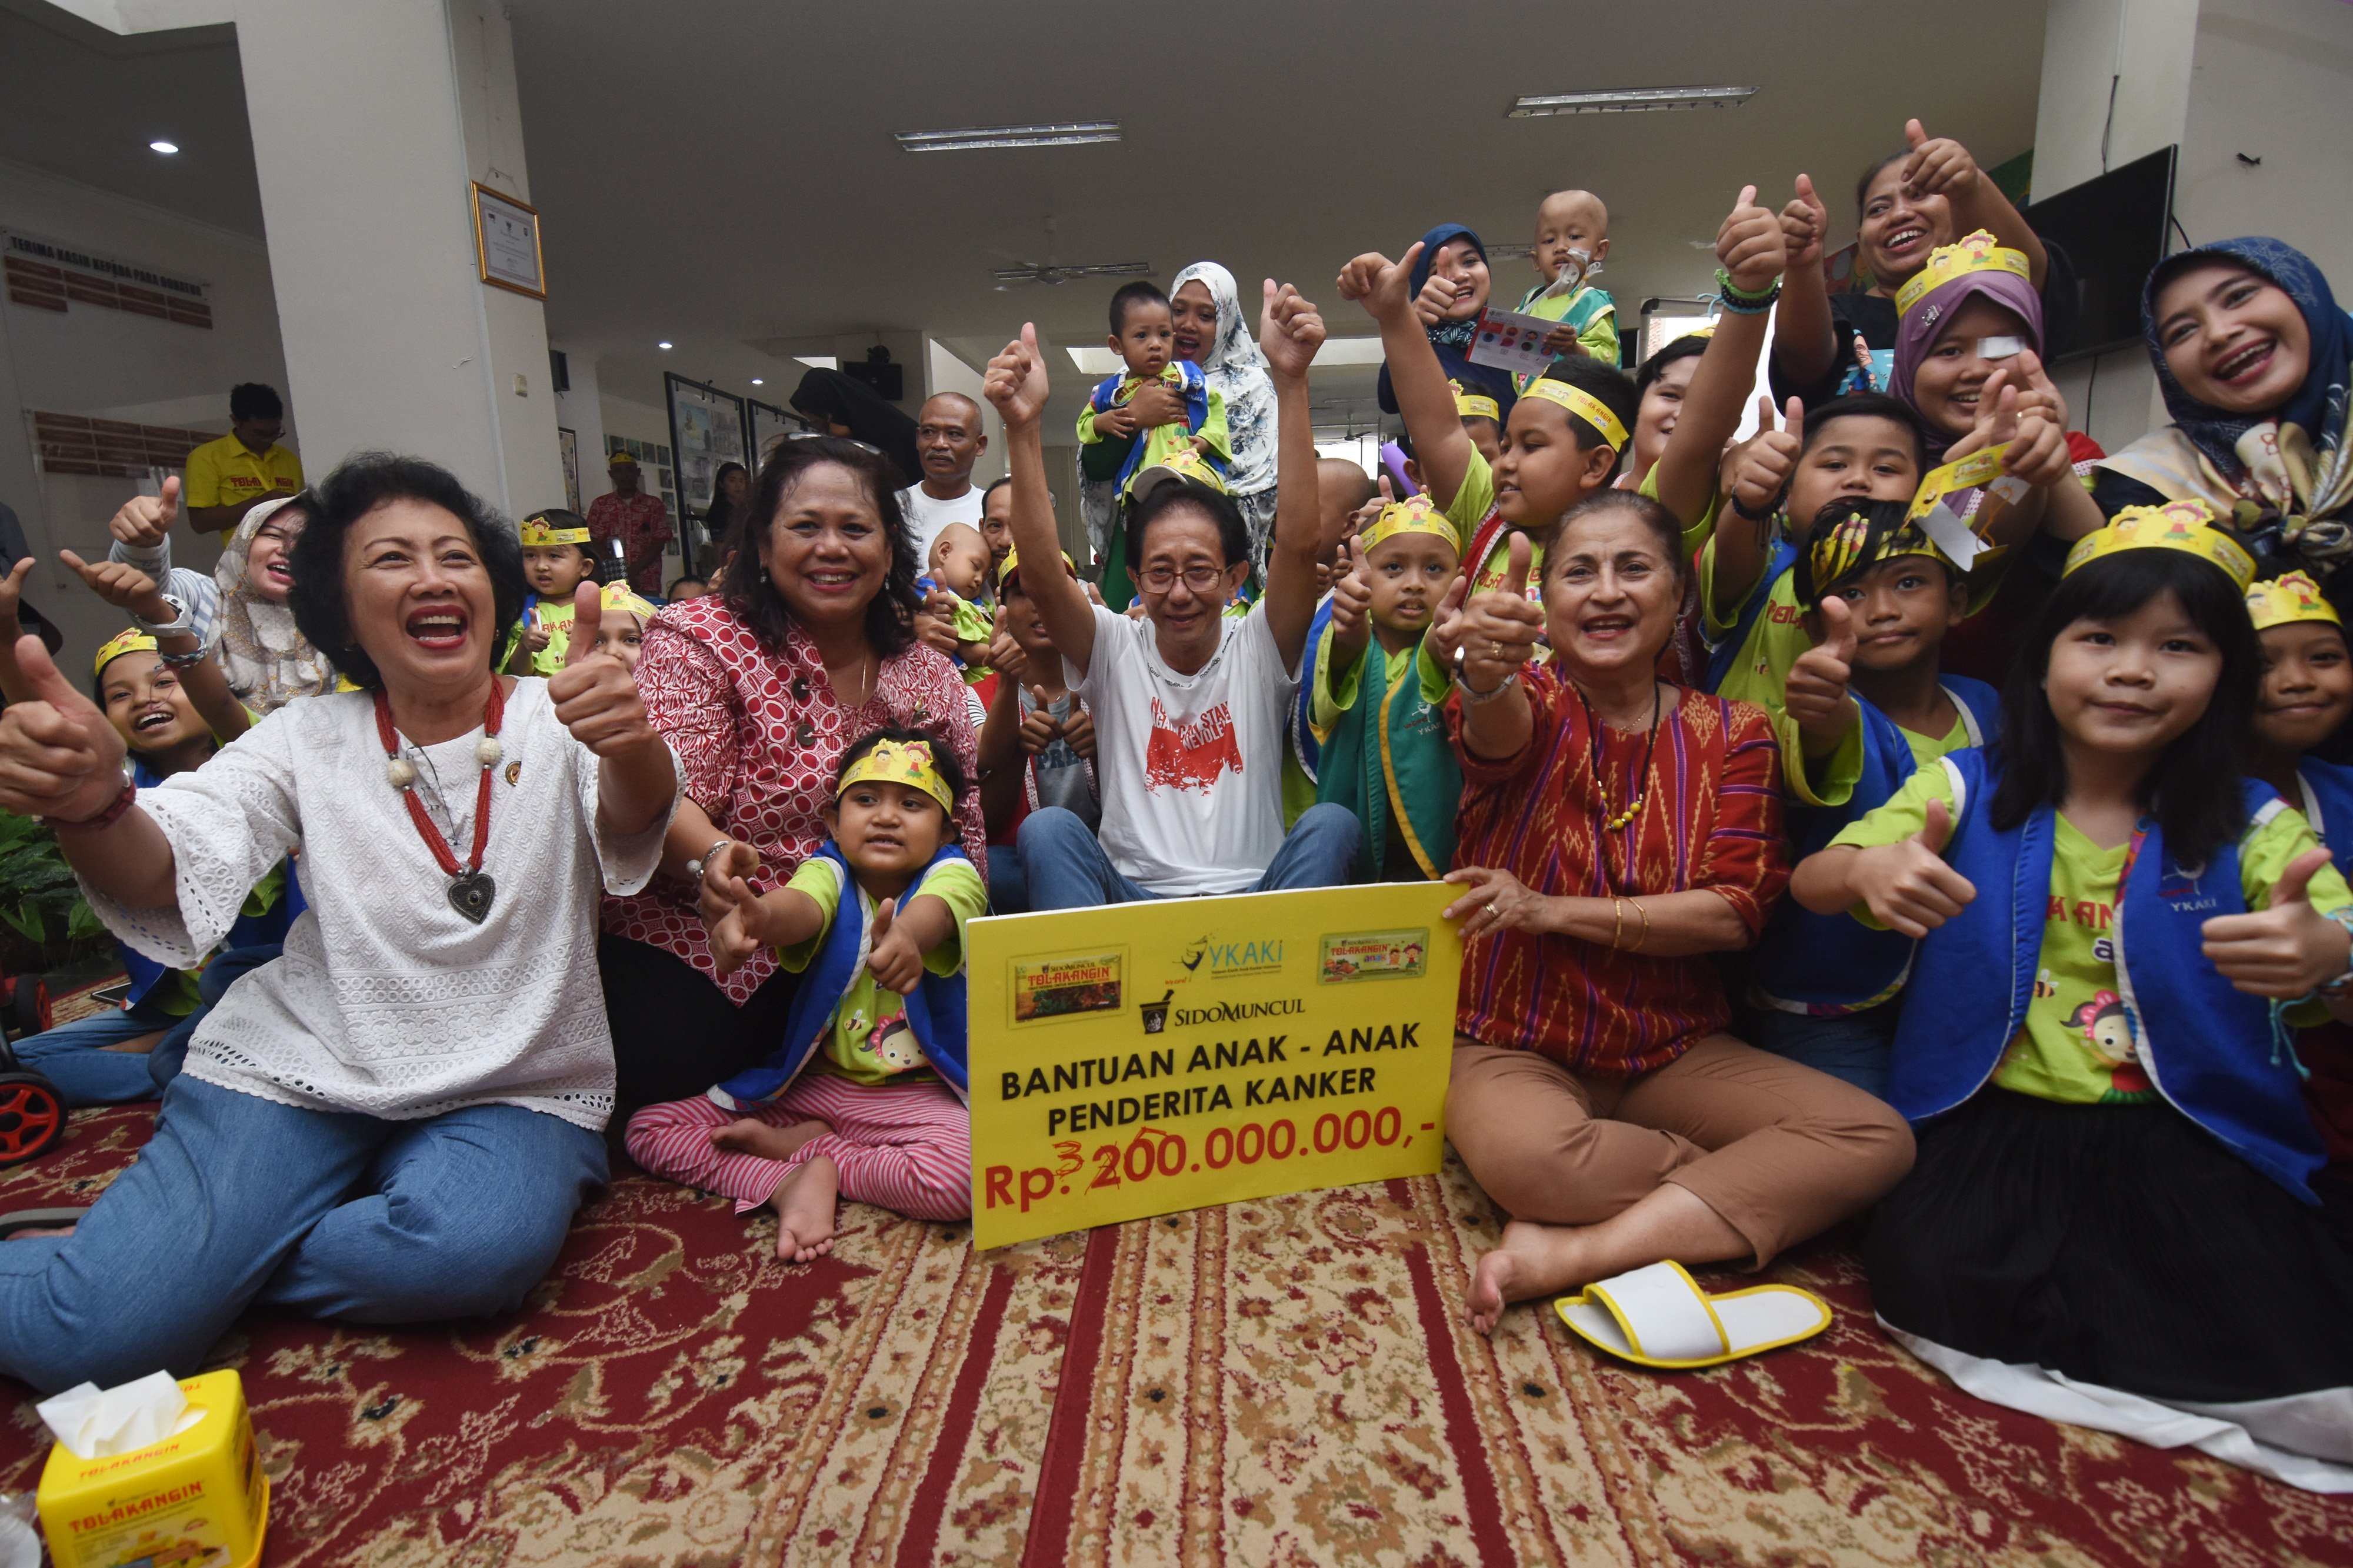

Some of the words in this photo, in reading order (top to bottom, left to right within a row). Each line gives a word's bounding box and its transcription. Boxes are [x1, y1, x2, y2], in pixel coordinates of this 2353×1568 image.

[11, 236, 55, 259] TERIMA
[56, 248, 91, 268] KASIH
[134, 269, 159, 286] PARA
[1577, 395, 1596, 411] TOLAK
[1595, 408, 1612, 423] ANGIN
[230, 476, 262, 487] TOLA
[2170, 898, 2217, 912] YKAKI
[1175, 998, 1305, 1027] SIDOMUNCUL
[1001, 1049, 1175, 1101] BANTUAN
[1187, 1036, 1288, 1074] ANAK
[1323, 1023, 1421, 1057] ANAK
[1048, 1086, 1233, 1136] PENDERITA
[1245, 1067, 1376, 1106] KANKER
[985, 1165, 1071, 1213] Rp.
